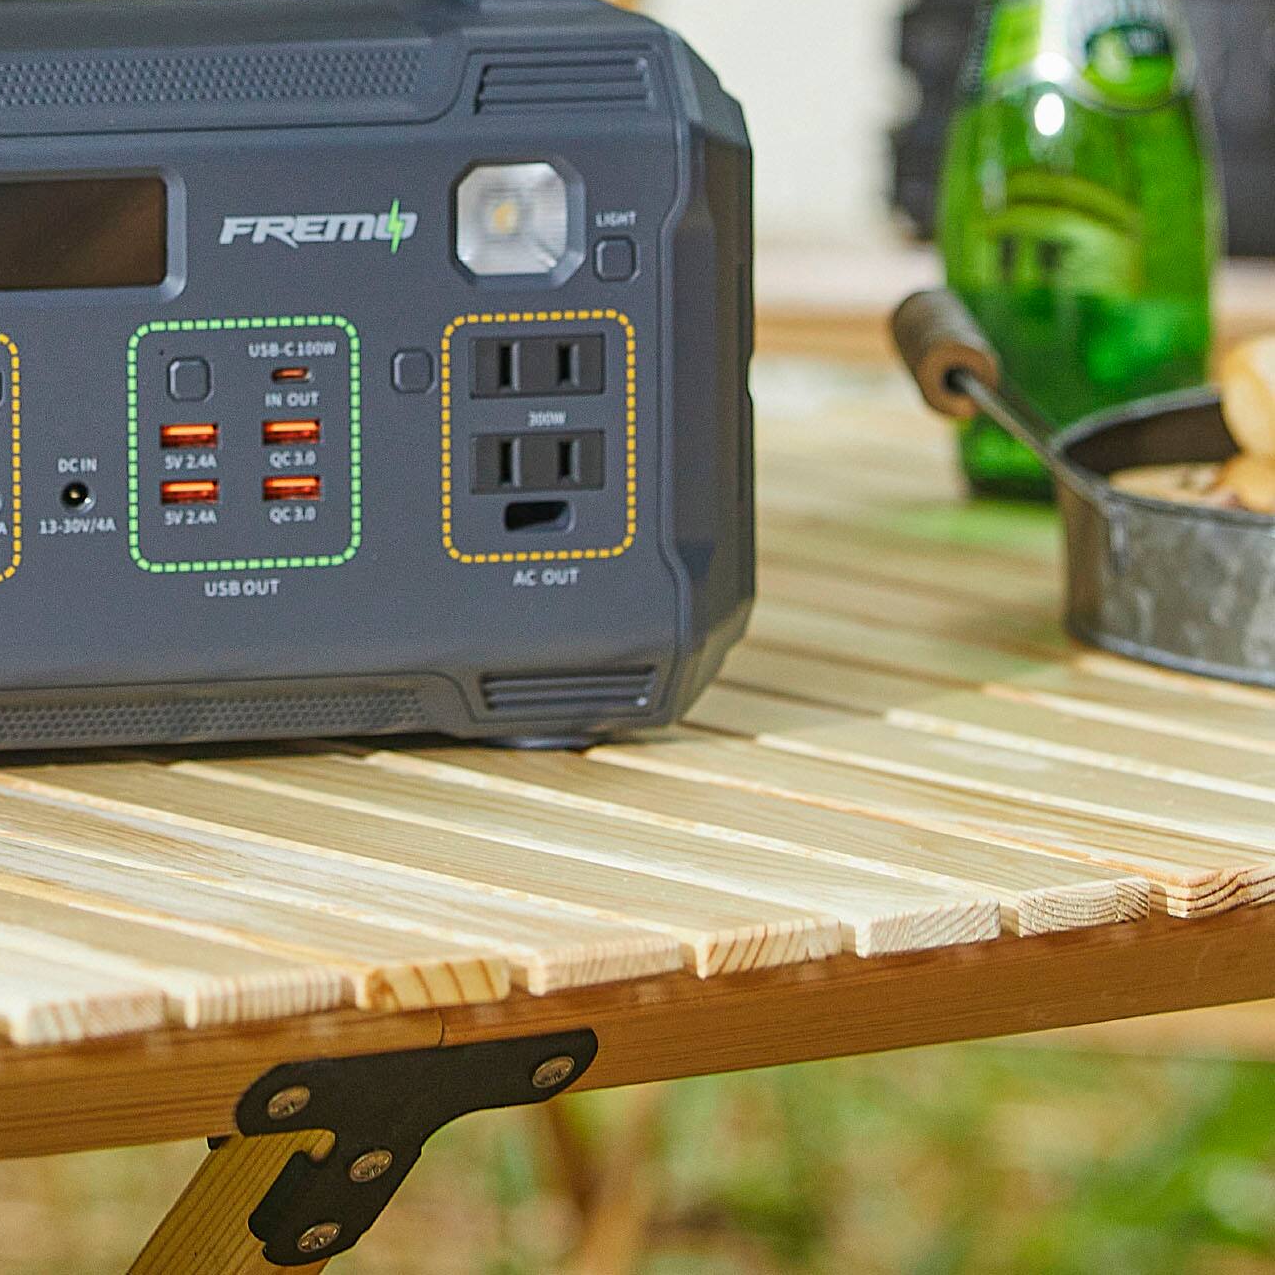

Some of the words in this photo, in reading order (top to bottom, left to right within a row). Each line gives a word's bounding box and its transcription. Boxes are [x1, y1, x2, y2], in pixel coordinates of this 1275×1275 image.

[595, 211, 637, 228] LIGHT
[248, 341, 296, 358] USB-C
[265, 392, 282, 407] IN
[286, 391, 319, 407] OUT
[58, 458, 79, 473] DC
[80, 458, 98, 472] IN
[164, 454, 183, 470] 5V
[186, 453, 218, 469] 2.4A
[269, 451, 291, 468] QC
[295, 450, 317, 466] 3.0
[164, 510, 183, 525] 5V
[186, 509, 218, 524] 2.4A
[269, 507, 291, 524] QC
[295, 506, 317, 521] 3.0
[39, 518, 117, 535] 13-30V/4A
[512, 568, 536, 586] AC
[541, 566, 580, 585] OUT
[204, 580, 241, 597] USB
[242, 578, 281, 596] OUT
